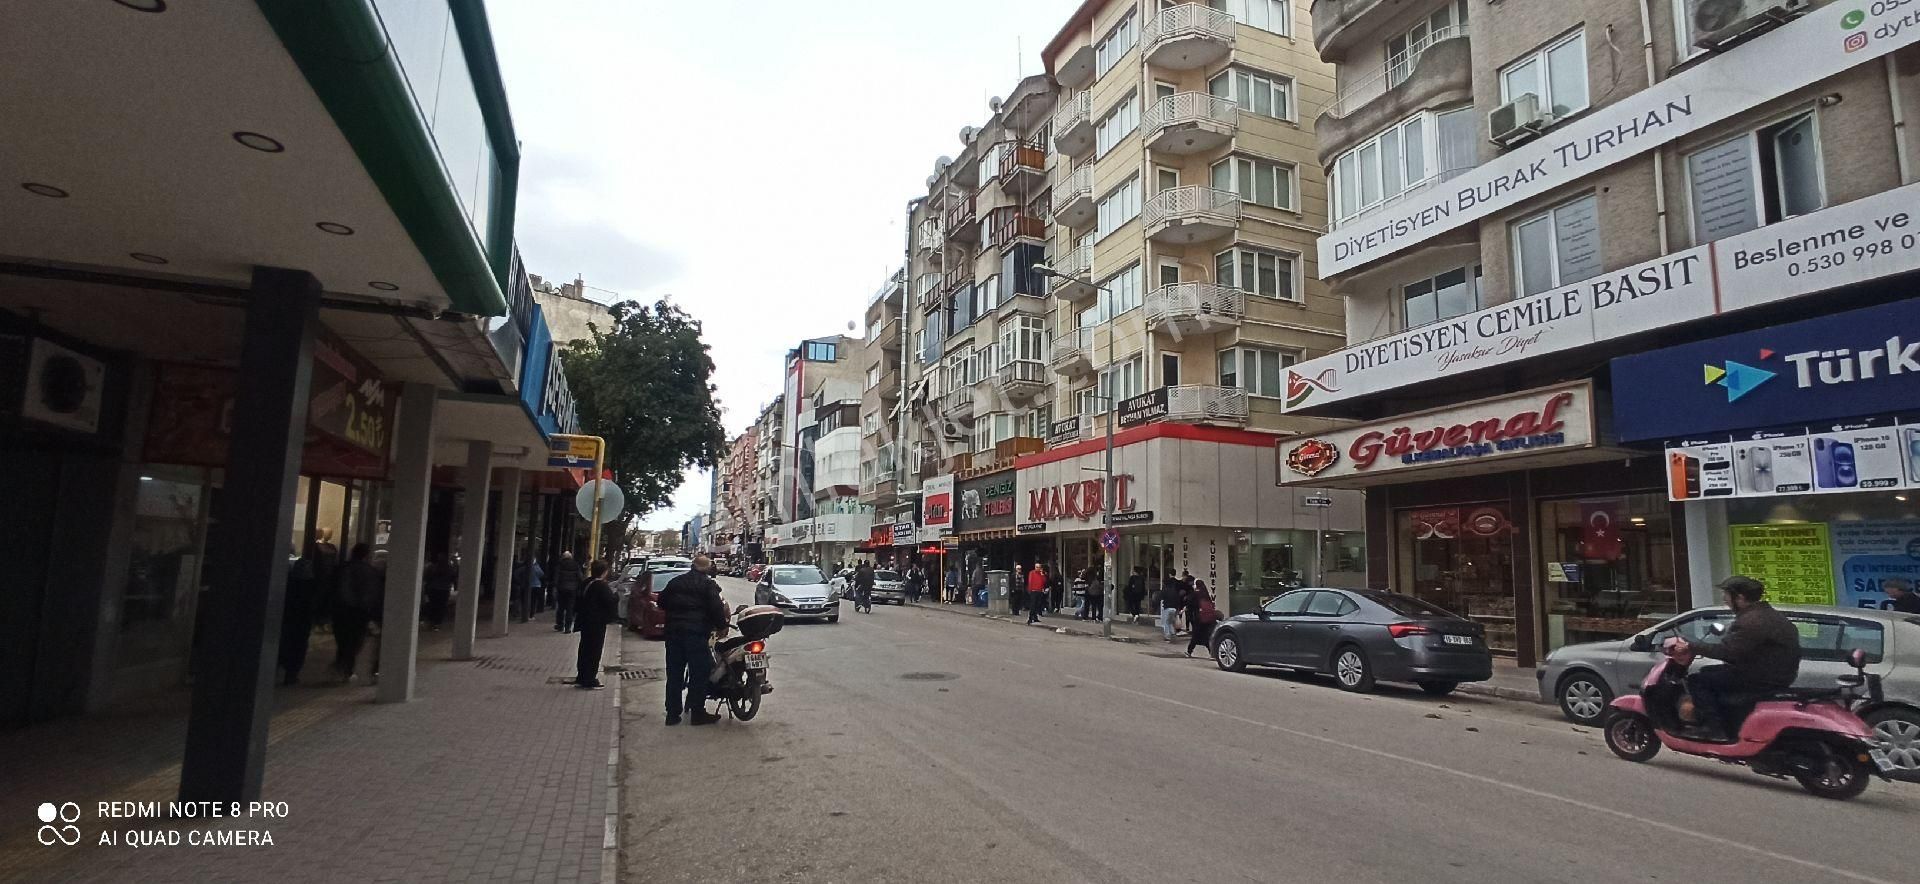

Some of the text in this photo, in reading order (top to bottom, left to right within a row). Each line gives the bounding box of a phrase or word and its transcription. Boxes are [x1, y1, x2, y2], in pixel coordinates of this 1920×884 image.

[1457, 158, 1548, 213] BURAK
[1553, 95, 1693, 169] TURHAN
[1733, 212, 1910, 270] Beslenme ve
[1787, 251, 1846, 277] 0.530
[1853, 239, 1894, 262] 998
[1592, 254, 1701, 310] BASIT
[1784, 336, 1920, 389] Türk
[1127, 393, 1156, 412] AVUKAT
[1347, 391, 1575, 471] Güvenal
[1028, 473, 1137, 523] MAKBUL
